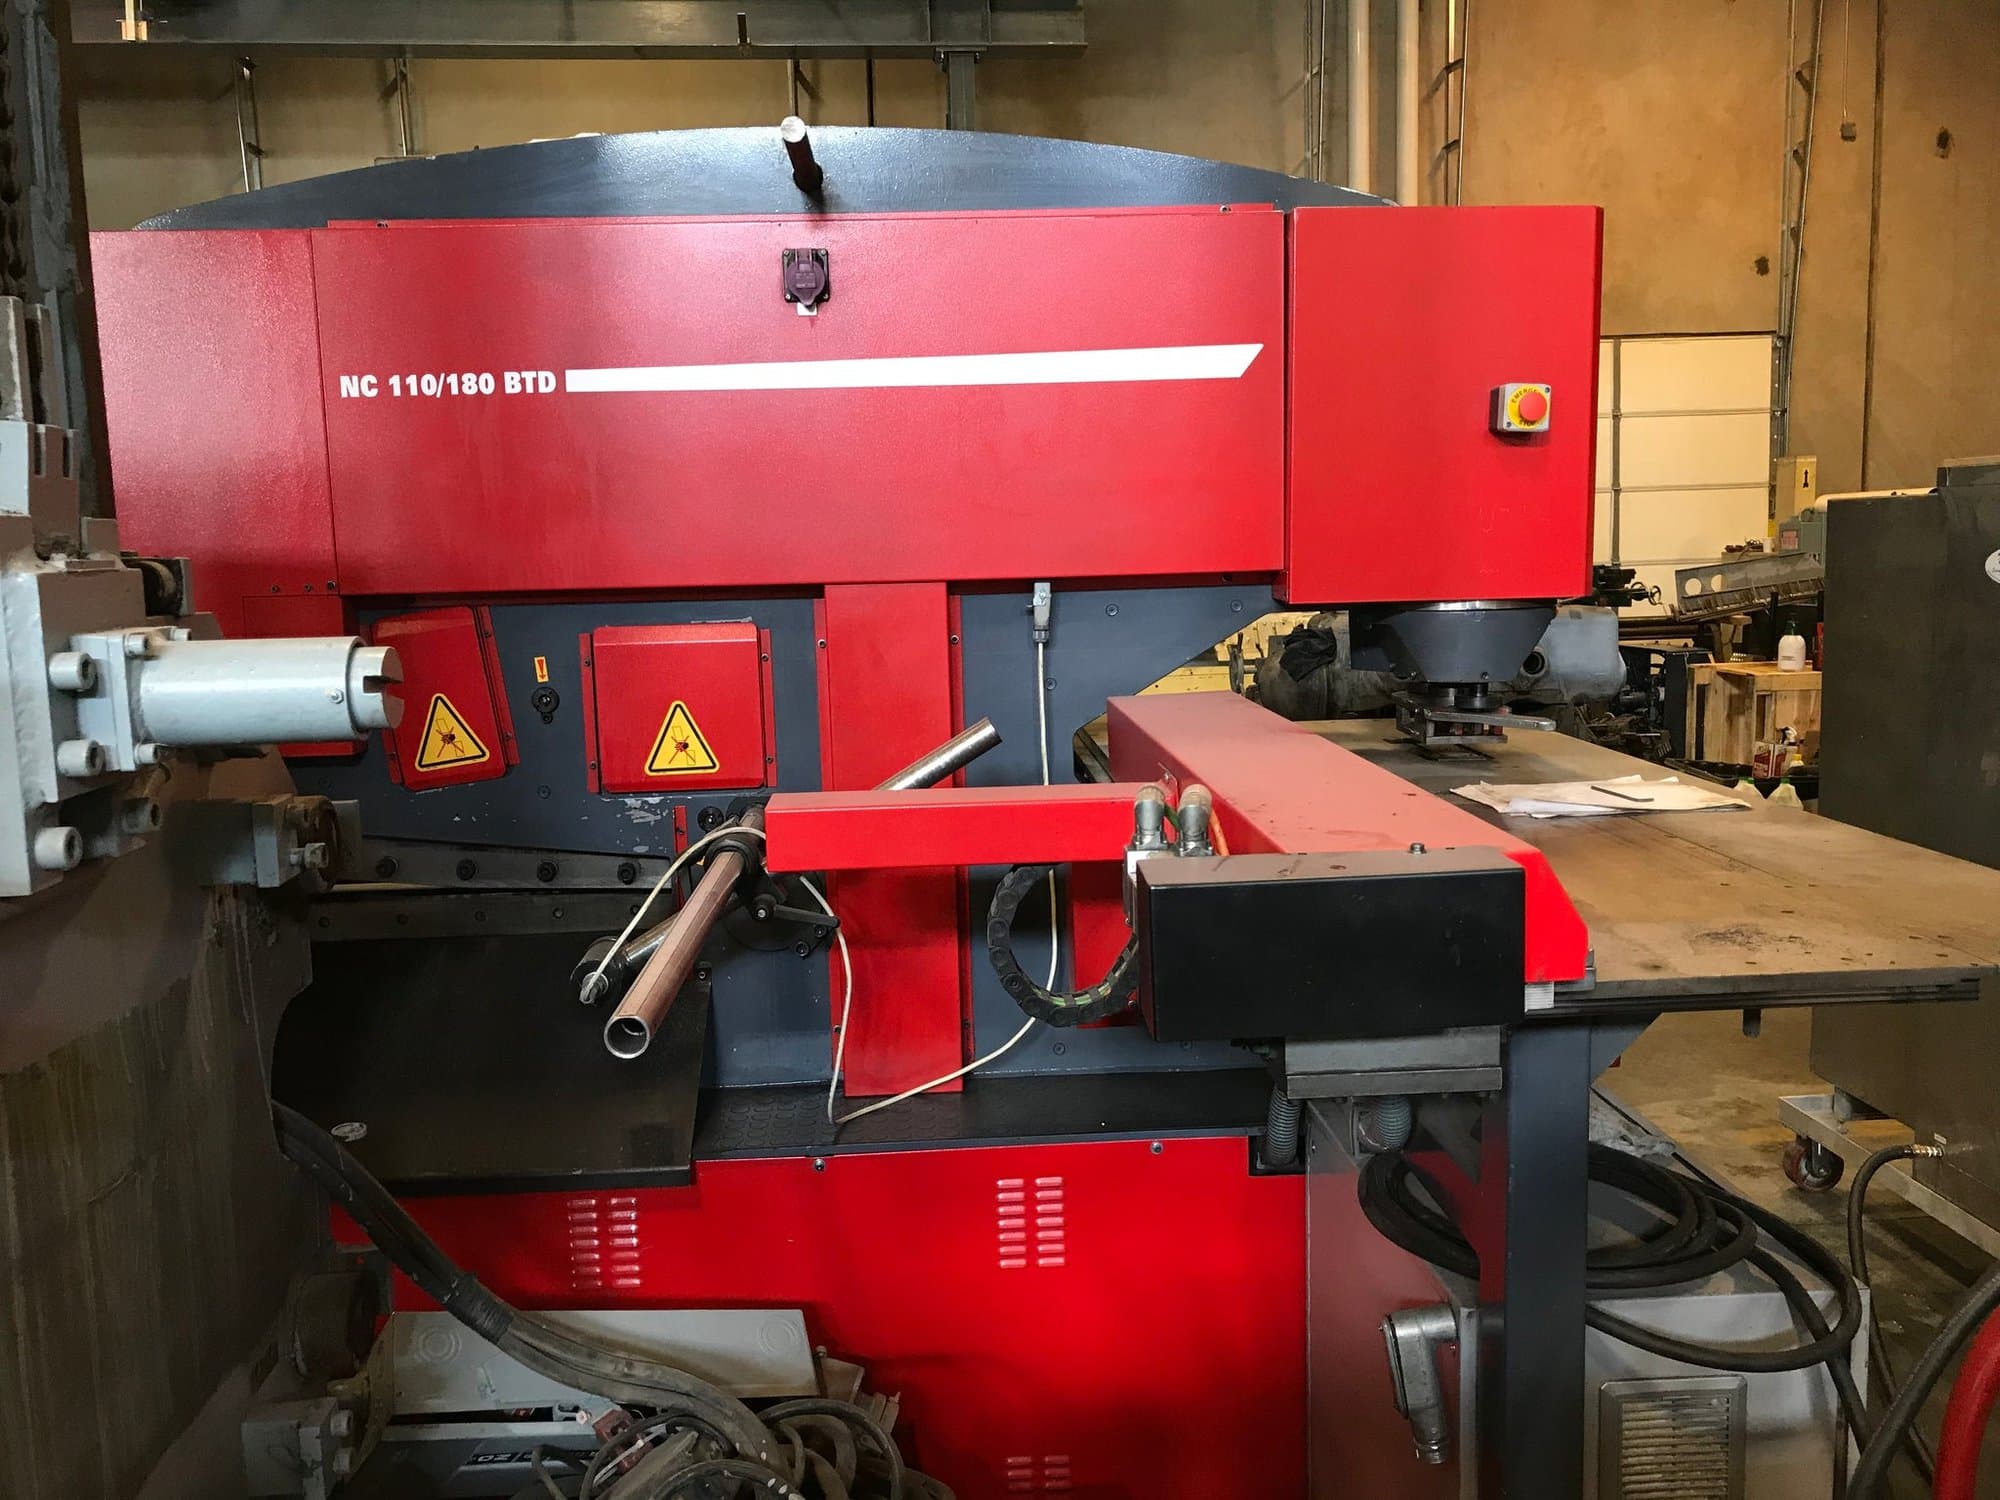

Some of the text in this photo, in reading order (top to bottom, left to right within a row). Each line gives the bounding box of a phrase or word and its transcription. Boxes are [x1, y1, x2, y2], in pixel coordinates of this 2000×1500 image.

[339, 370, 557, 398] NC 110/180 BTD
